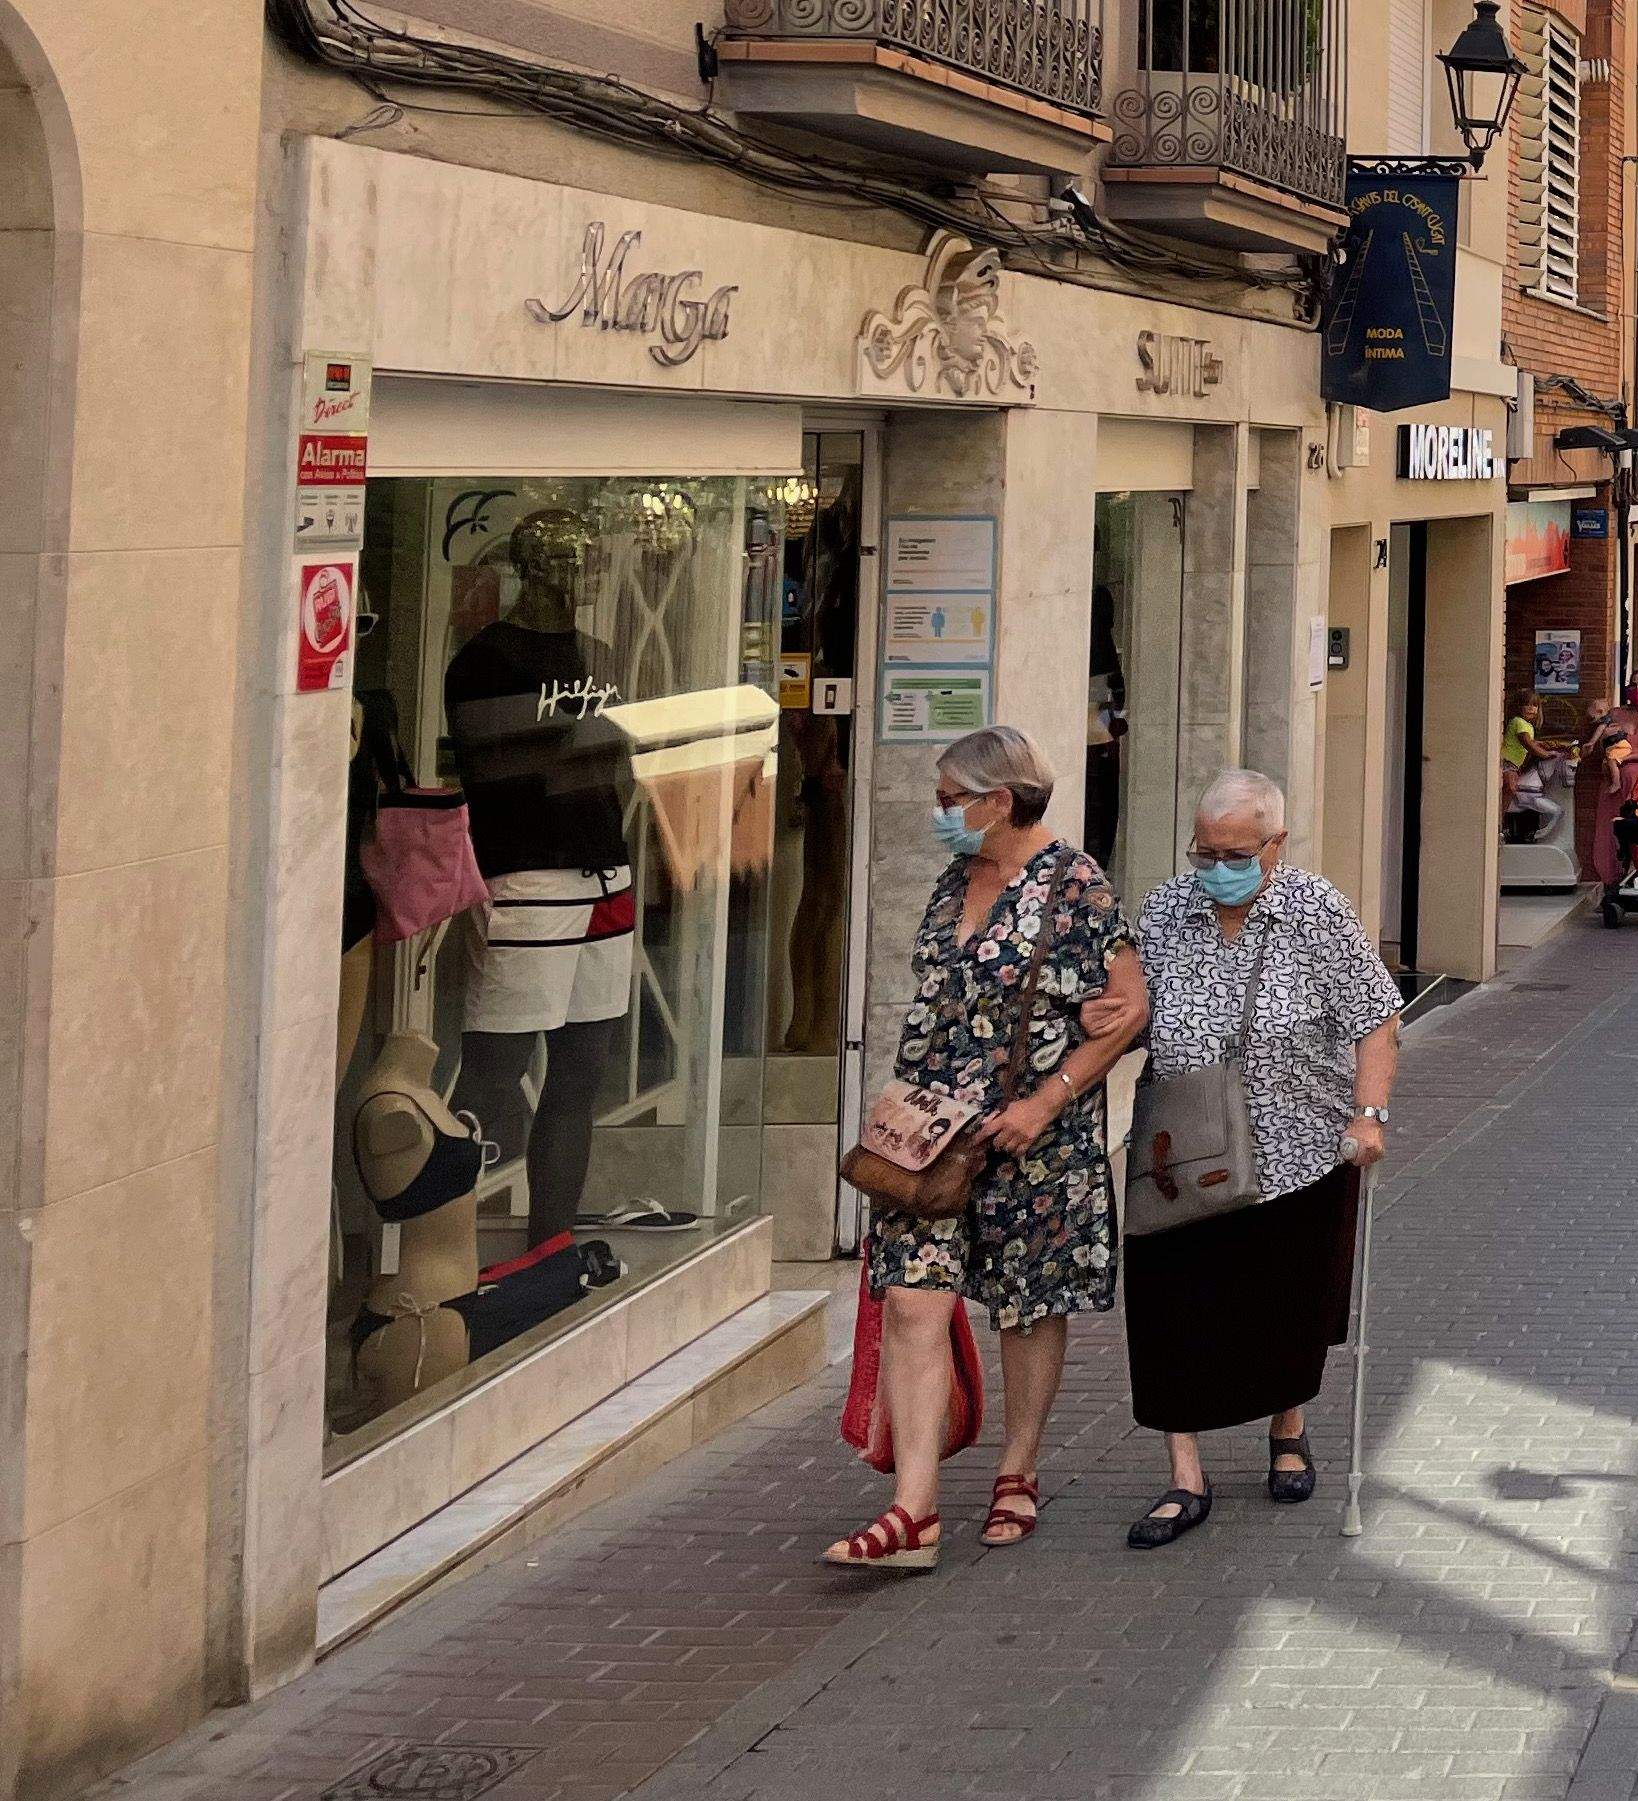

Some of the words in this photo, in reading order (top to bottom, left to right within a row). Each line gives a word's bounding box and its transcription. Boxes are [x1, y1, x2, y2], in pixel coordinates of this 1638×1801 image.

[1366, 328, 1404, 339] MODA
[300, 440, 366, 466] Alarma
[1409, 424, 1493, 480] MORELINE
